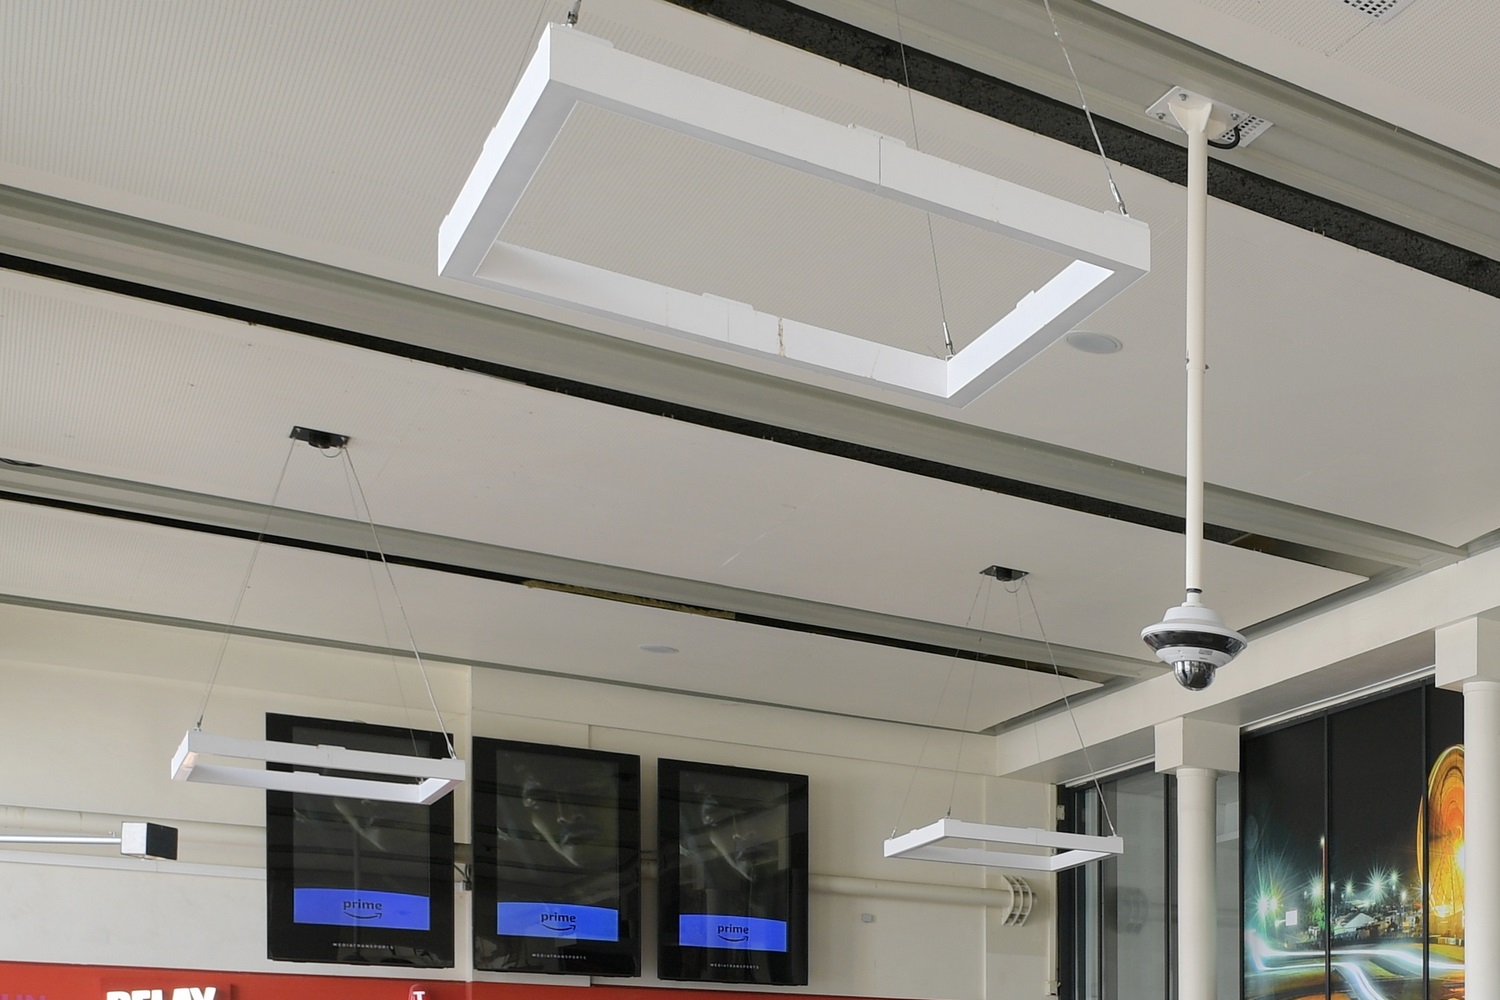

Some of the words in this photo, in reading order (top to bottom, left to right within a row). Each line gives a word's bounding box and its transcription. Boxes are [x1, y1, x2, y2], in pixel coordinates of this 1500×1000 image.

[343, 899, 382, 910] prime
[541, 912, 576, 922] prime
[717, 924, 749, 934] prime
